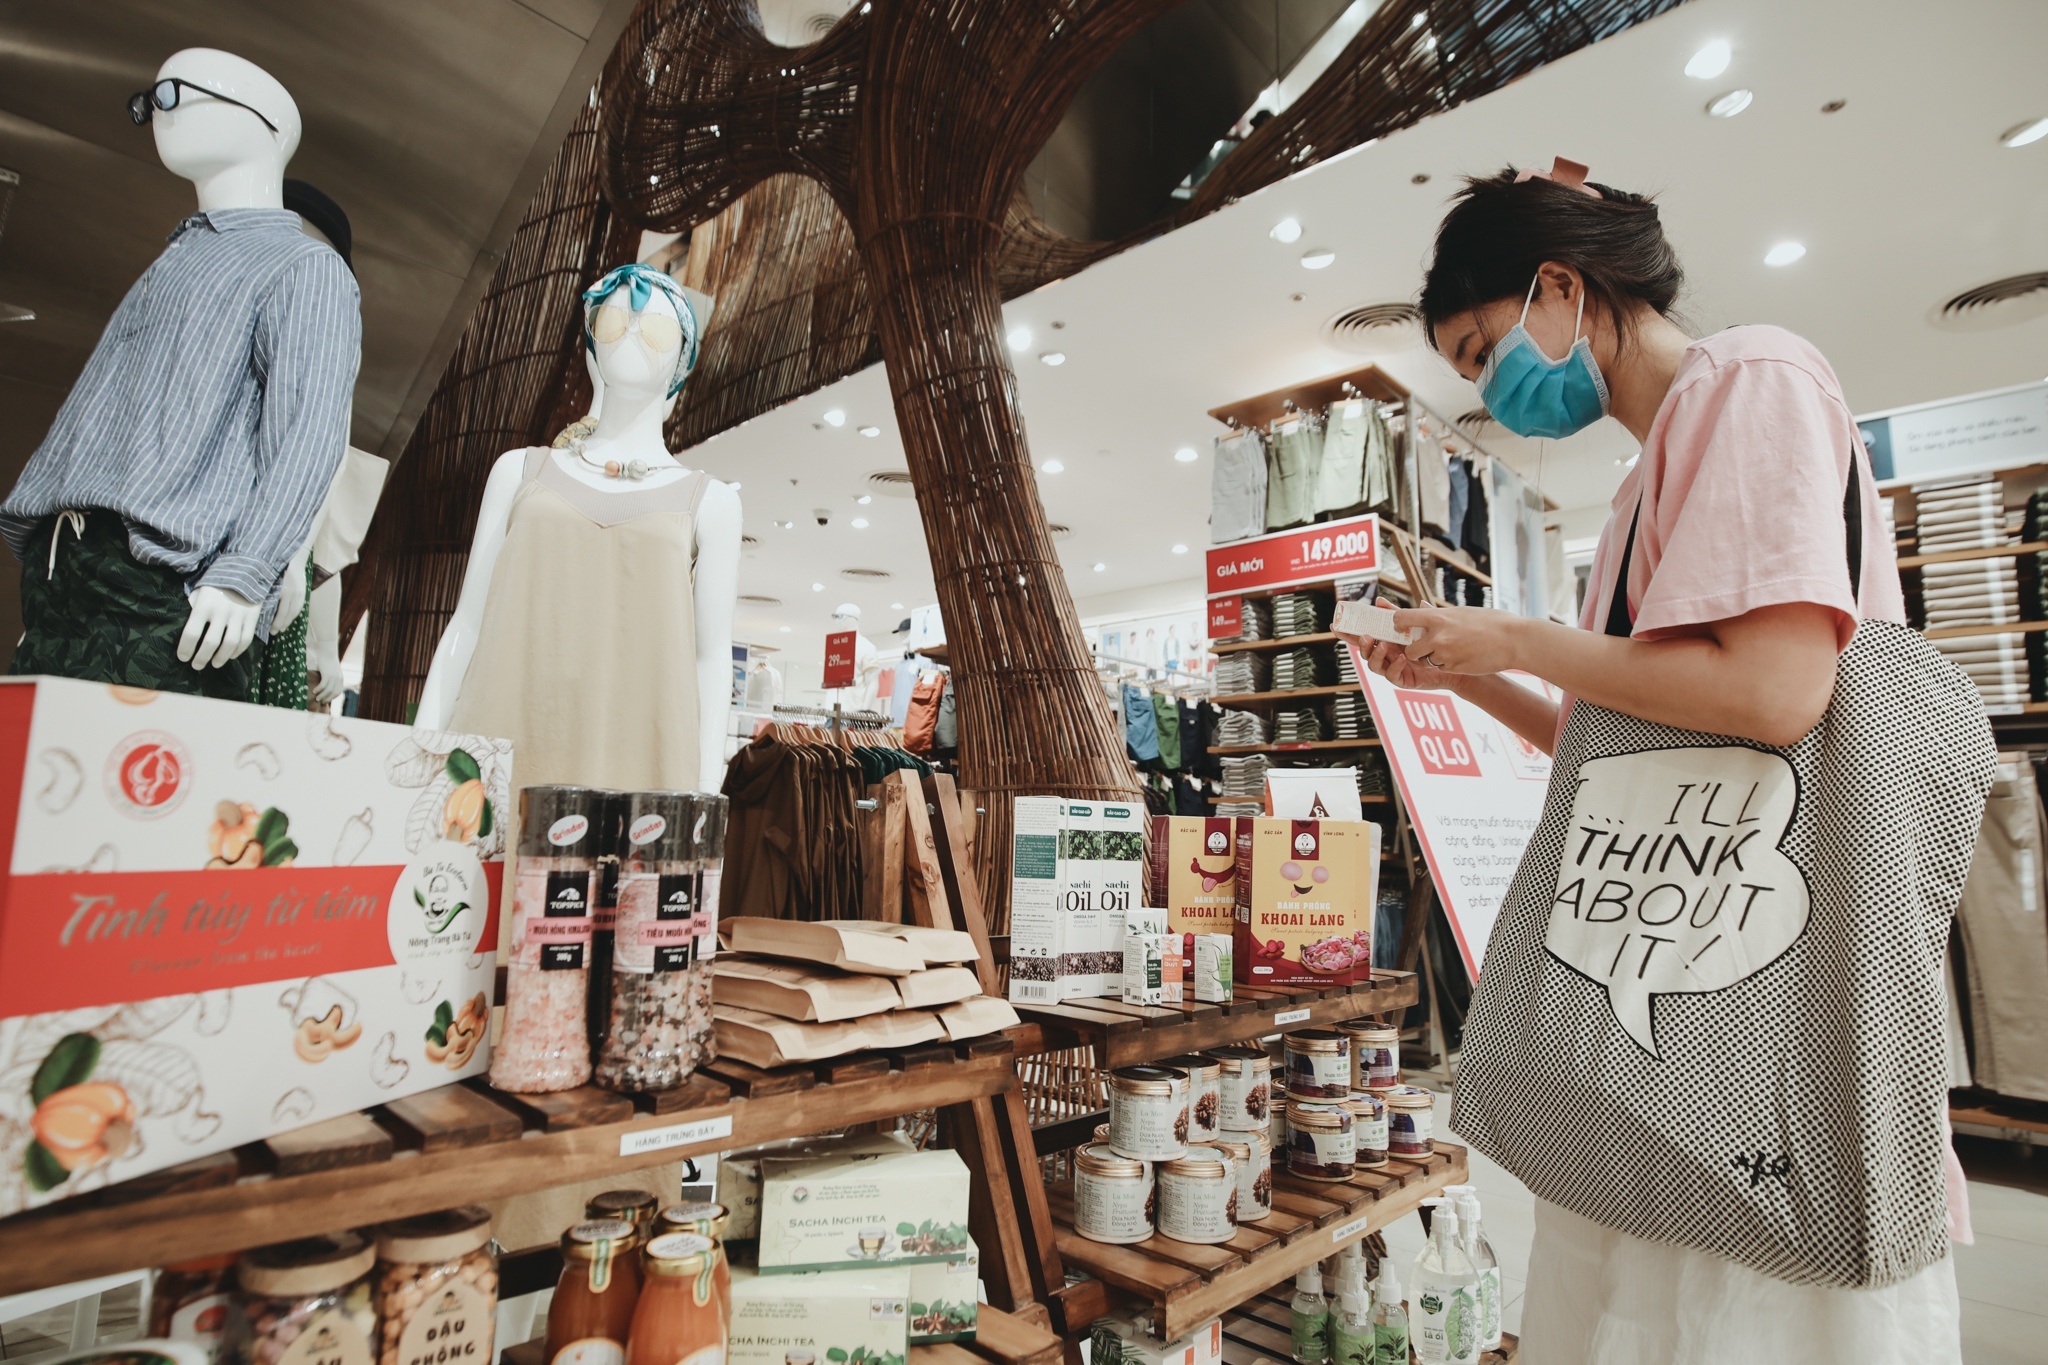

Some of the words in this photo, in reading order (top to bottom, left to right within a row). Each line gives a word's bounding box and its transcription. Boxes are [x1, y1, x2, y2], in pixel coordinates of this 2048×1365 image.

[1301, 530, 1369, 563] 149.000
[1216, 562, 1238, 578] GIÁ
[1240, 557, 1264, 573] MỚI
[1404, 700, 1455, 732] UNI
[1419, 734, 1471, 769] QLO
[1436, 815, 1451, 826] Với
[1452, 818, 1478, 829] mong
[552, 820, 586, 842] Grinder
[632, 820, 662, 841] Grinder
[1576, 826, 1761, 876] THINK
[1070, 880, 1091, 888] sachi
[1105, 880, 1129, 889] sachi
[1181, 907, 1217, 918] KHOAI
[1222, 907, 1236, 918] LA
[1277, 900, 1300, 910] BÁNH
[1553, 878, 1776, 931] ABOUT
[1261, 913, 1303, 926] KHOAI
[1310, 914, 1345, 926] LANG
[430, 935, 450, 945] Trang
[635, 1136, 661, 1149] HÀNG
[665, 1130, 695, 1144] TRƯNG
[789, 1218, 828, 1228] SACHA
[832, 1216, 863, 1225] INCHI
[866, 1215, 886, 1224] TEA
[729, 1337, 753, 1346] CHA
[757, 1336, 790, 1346] INCHI
[795, 1338, 815, 1346] TEA
